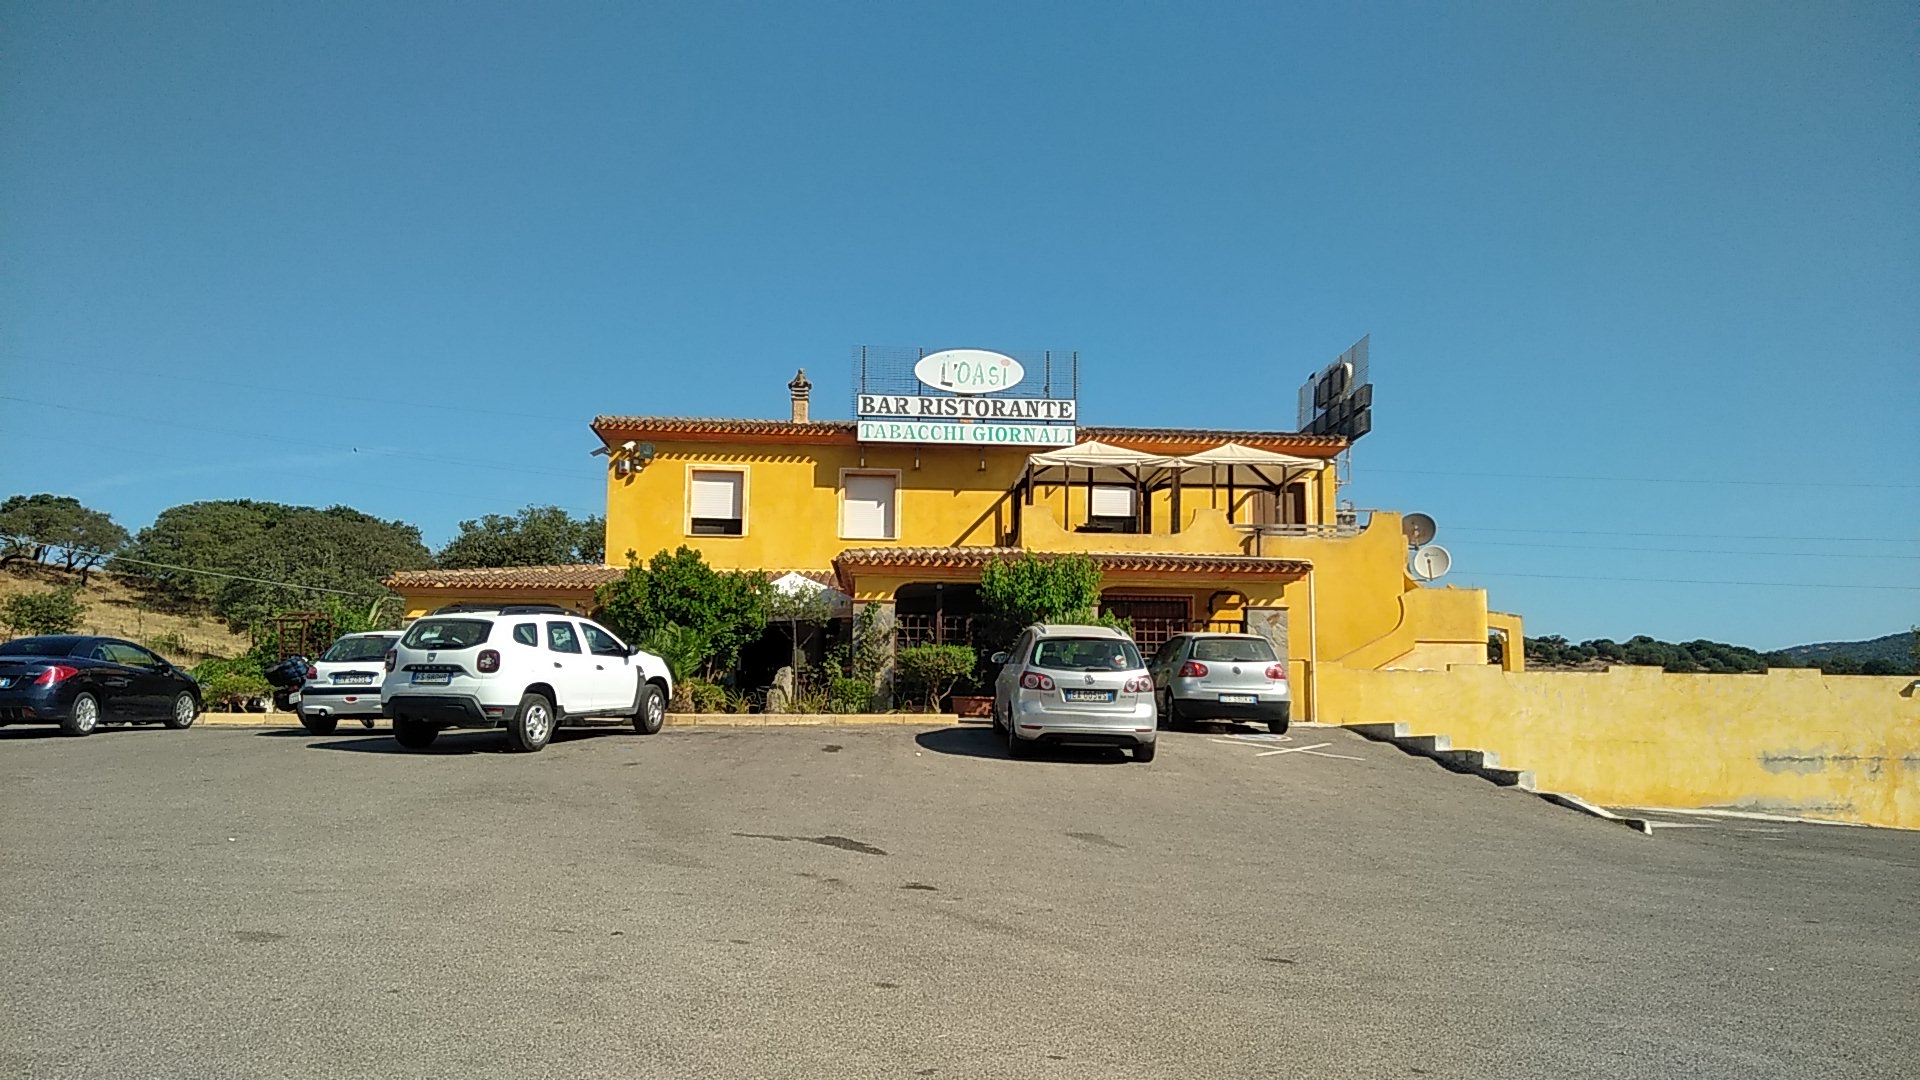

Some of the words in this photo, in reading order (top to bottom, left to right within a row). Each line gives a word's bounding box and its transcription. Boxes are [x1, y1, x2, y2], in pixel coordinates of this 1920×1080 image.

[860, 396, 910, 415] BAR
[918, 397, 1073, 419] RISTORANTE
[860, 423, 965, 441] TABACCHI
[973, 427, 1073, 444] GIORNALI
